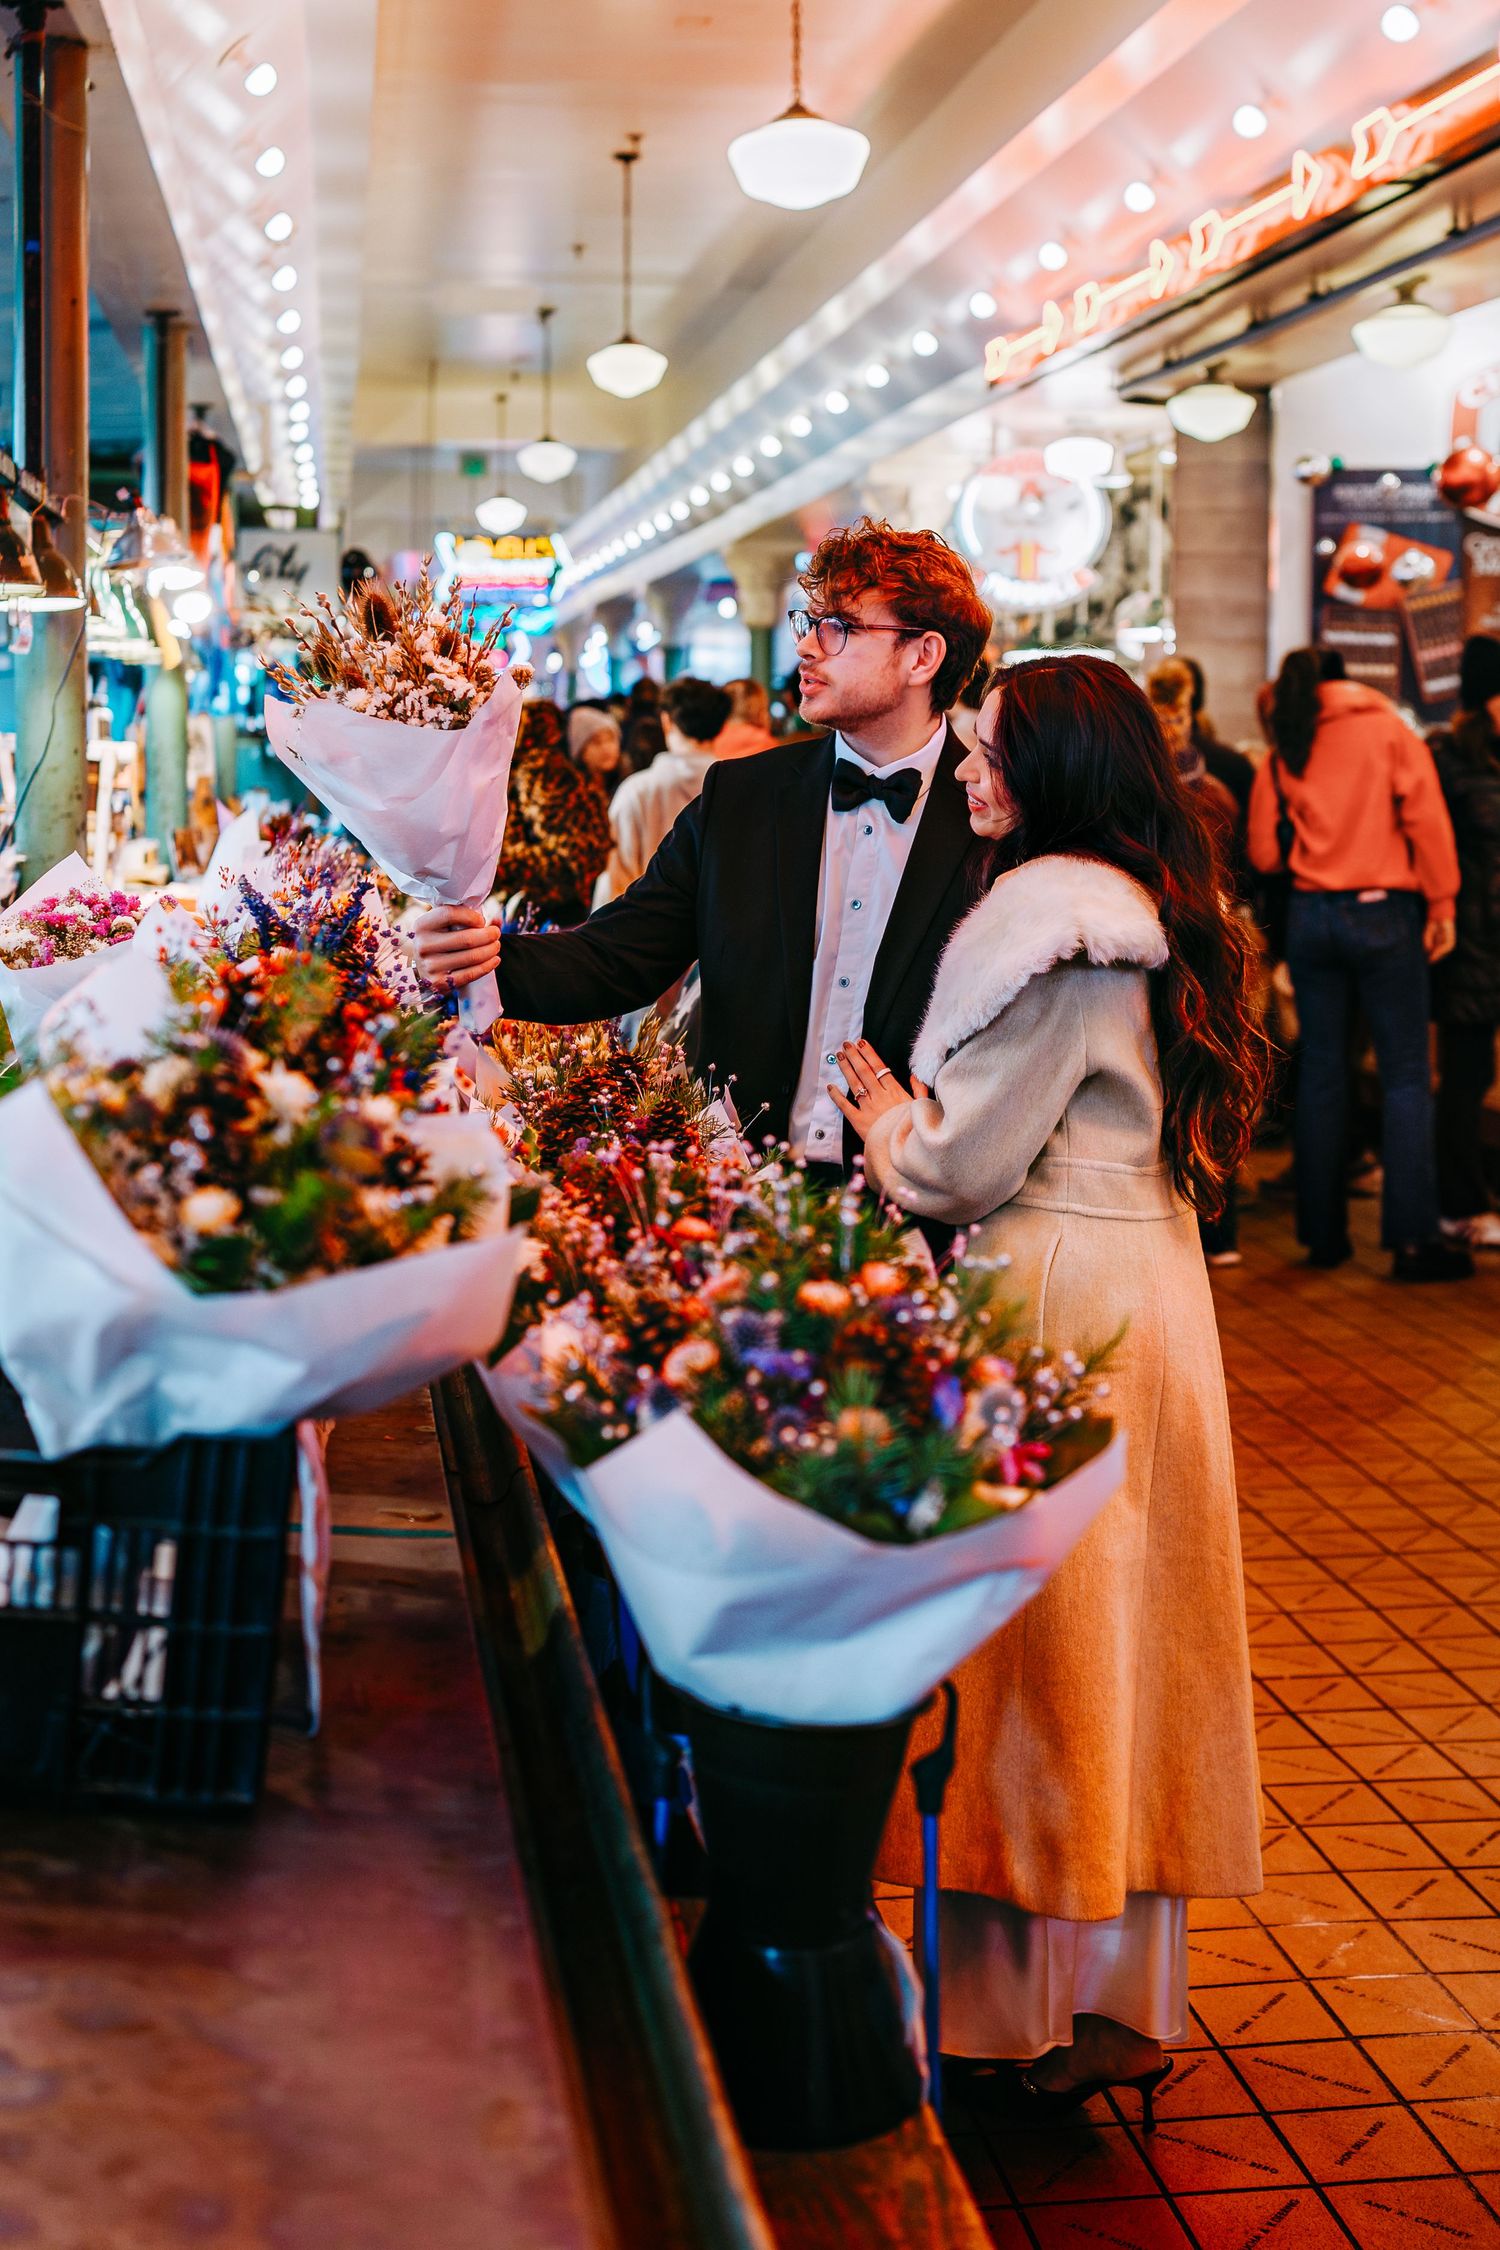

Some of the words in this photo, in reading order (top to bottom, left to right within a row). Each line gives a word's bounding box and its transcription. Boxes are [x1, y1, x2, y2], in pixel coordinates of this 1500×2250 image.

[1252, 2057, 1308, 2076] SHANNON
[1154, 2132, 1185, 2145] JOHN
[1414, 2217, 1473, 2238] CROWLEY
